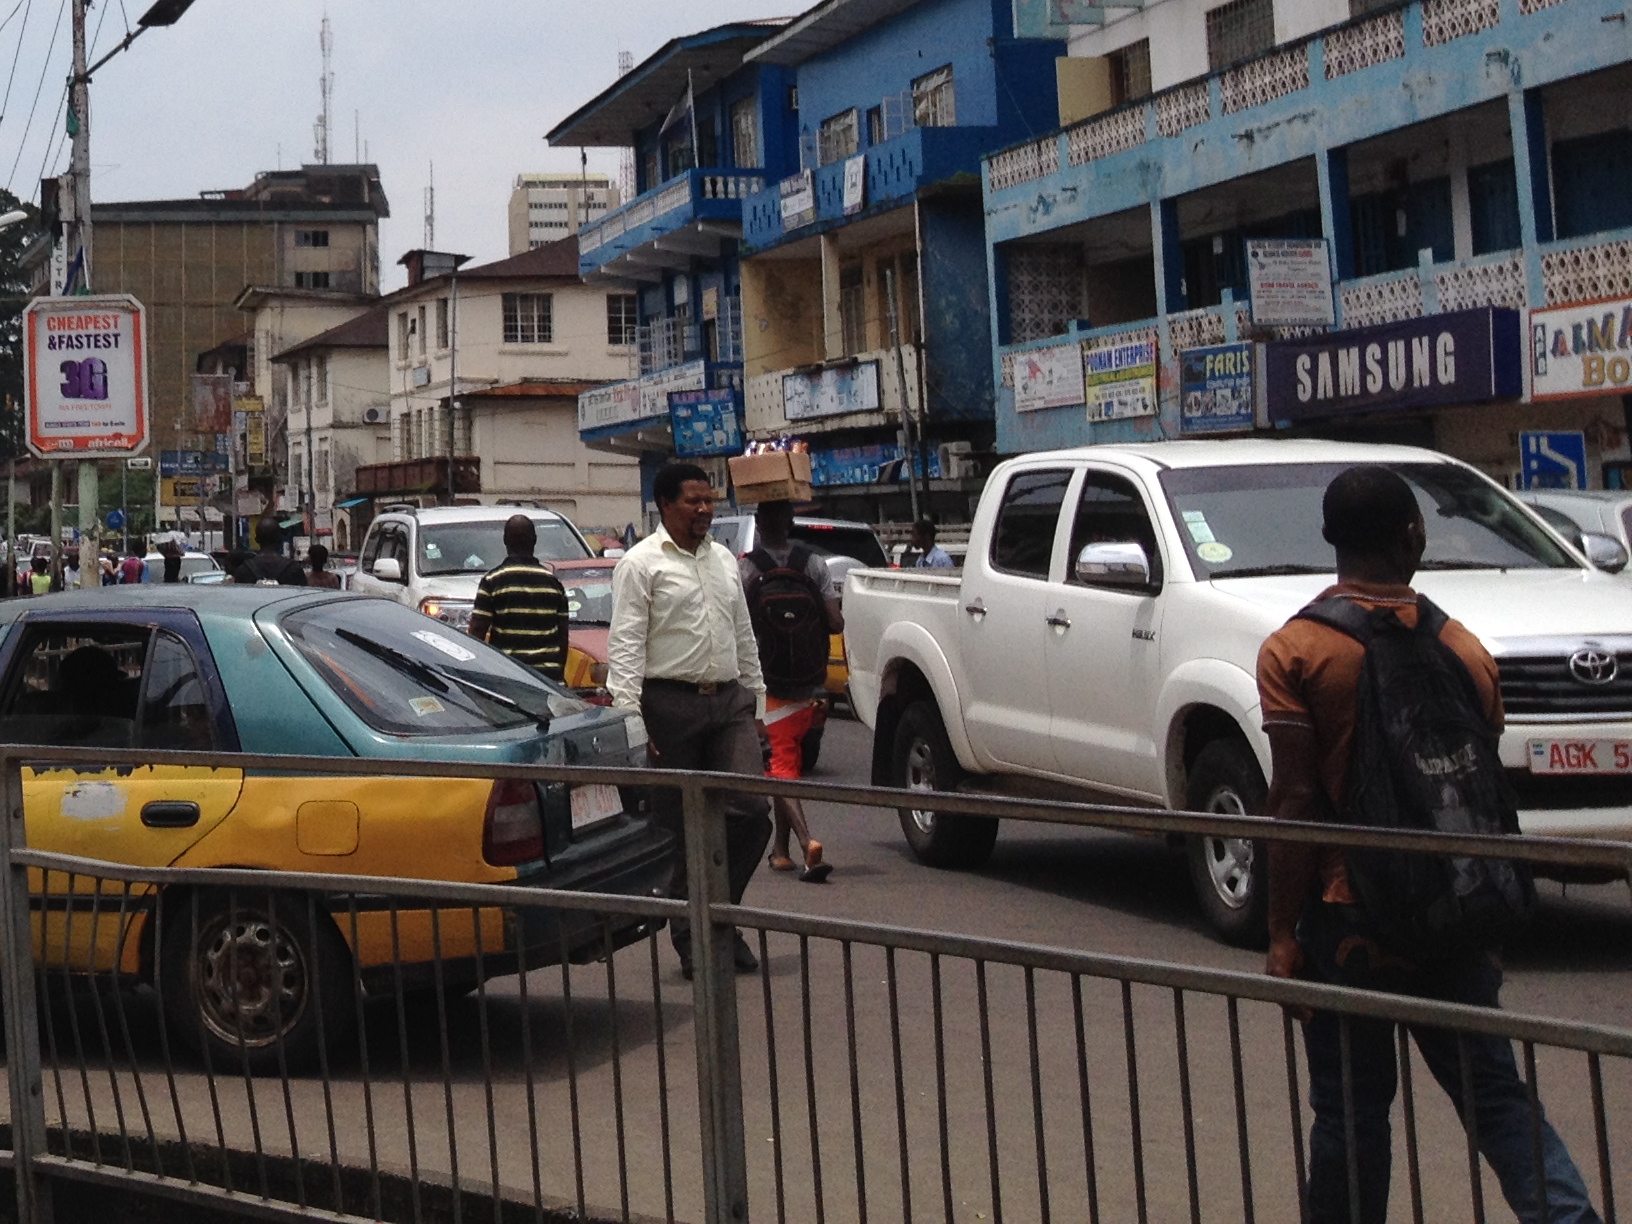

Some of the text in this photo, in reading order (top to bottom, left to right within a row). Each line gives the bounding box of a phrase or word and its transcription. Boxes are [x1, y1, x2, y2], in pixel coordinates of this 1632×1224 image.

[47, 315, 120, 331] CHEAPEST
[48, 333, 121, 350] &FASTEST
[1206, 350, 1249, 378] FARIS
[1296, 331, 1456, 403] SAMSUNG
[60, 357, 108, 400] 3G
[1549, 742, 1632, 769] AGK 5
